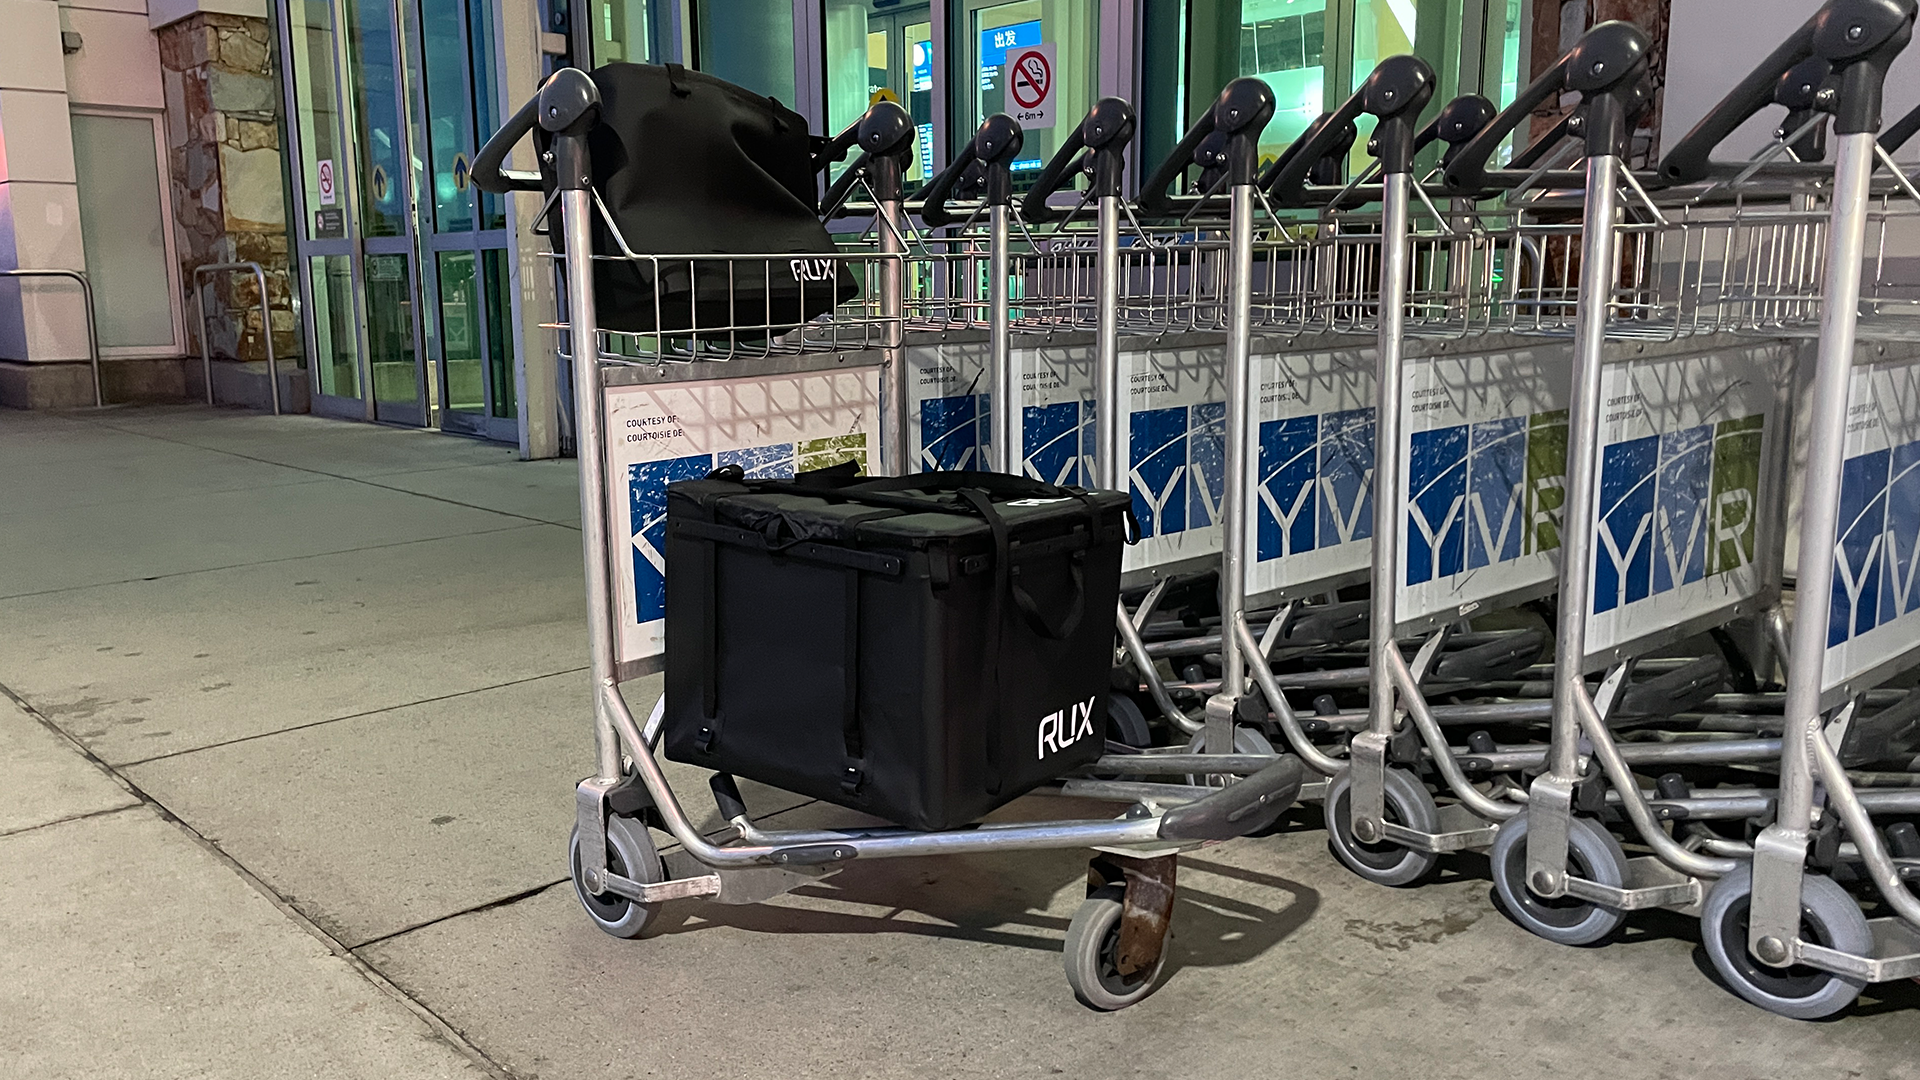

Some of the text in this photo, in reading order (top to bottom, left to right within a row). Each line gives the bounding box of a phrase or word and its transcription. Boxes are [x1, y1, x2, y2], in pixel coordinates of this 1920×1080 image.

[994, 30, 1017, 48] 出发
[1025, 112, 1036, 120] 6m
[790, 259, 835, 282] RUX
[626, 416, 666, 428] COURTESY
[627, 430, 671, 442] COURTOISIE
[1408, 475, 1566, 580] YVR
[1598, 488, 1753, 606] YVR
[1038, 696, 1096, 760] RUX
